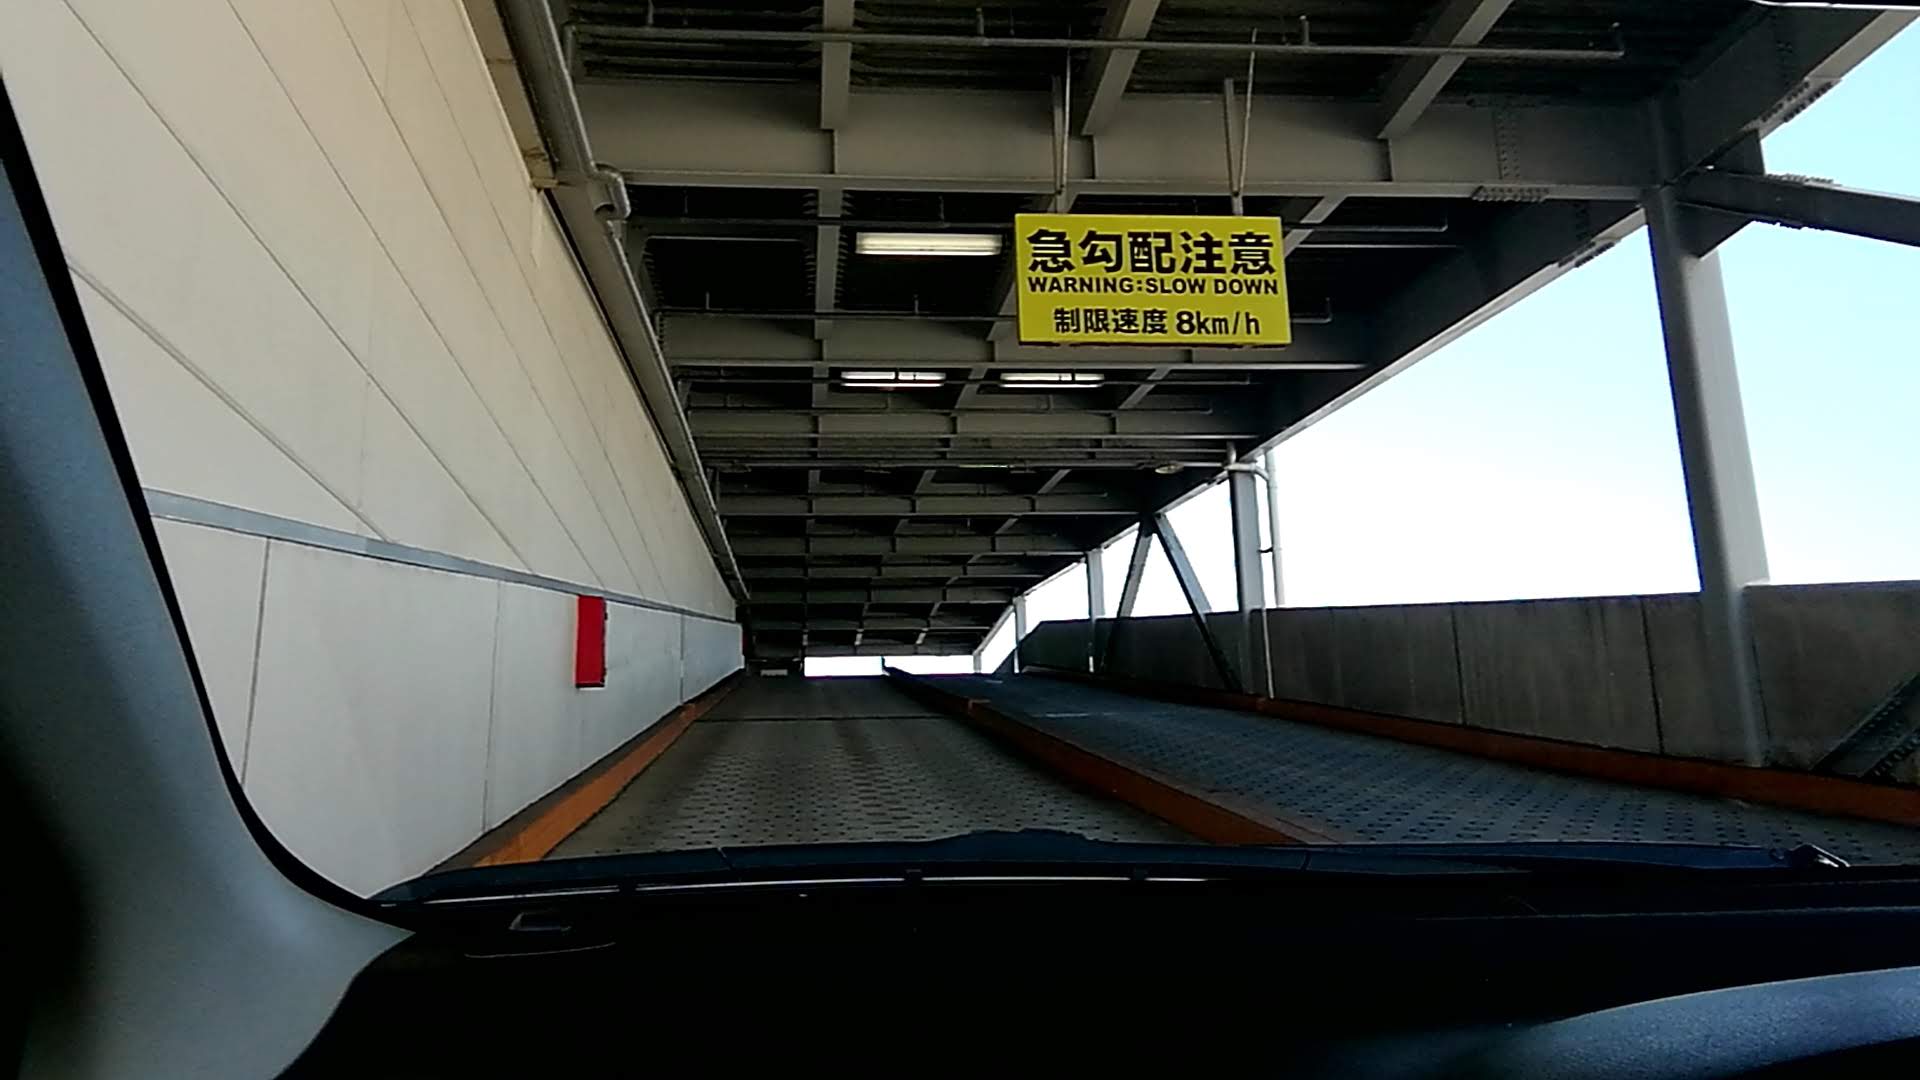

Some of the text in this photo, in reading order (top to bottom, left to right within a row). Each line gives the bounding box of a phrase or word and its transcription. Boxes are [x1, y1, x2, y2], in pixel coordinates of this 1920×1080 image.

[1027, 229, 1276, 275] 急勾配注意
[1214, 279, 1278, 295] DOWN
[1054, 308, 1260, 335] 制限速度 8km/h
